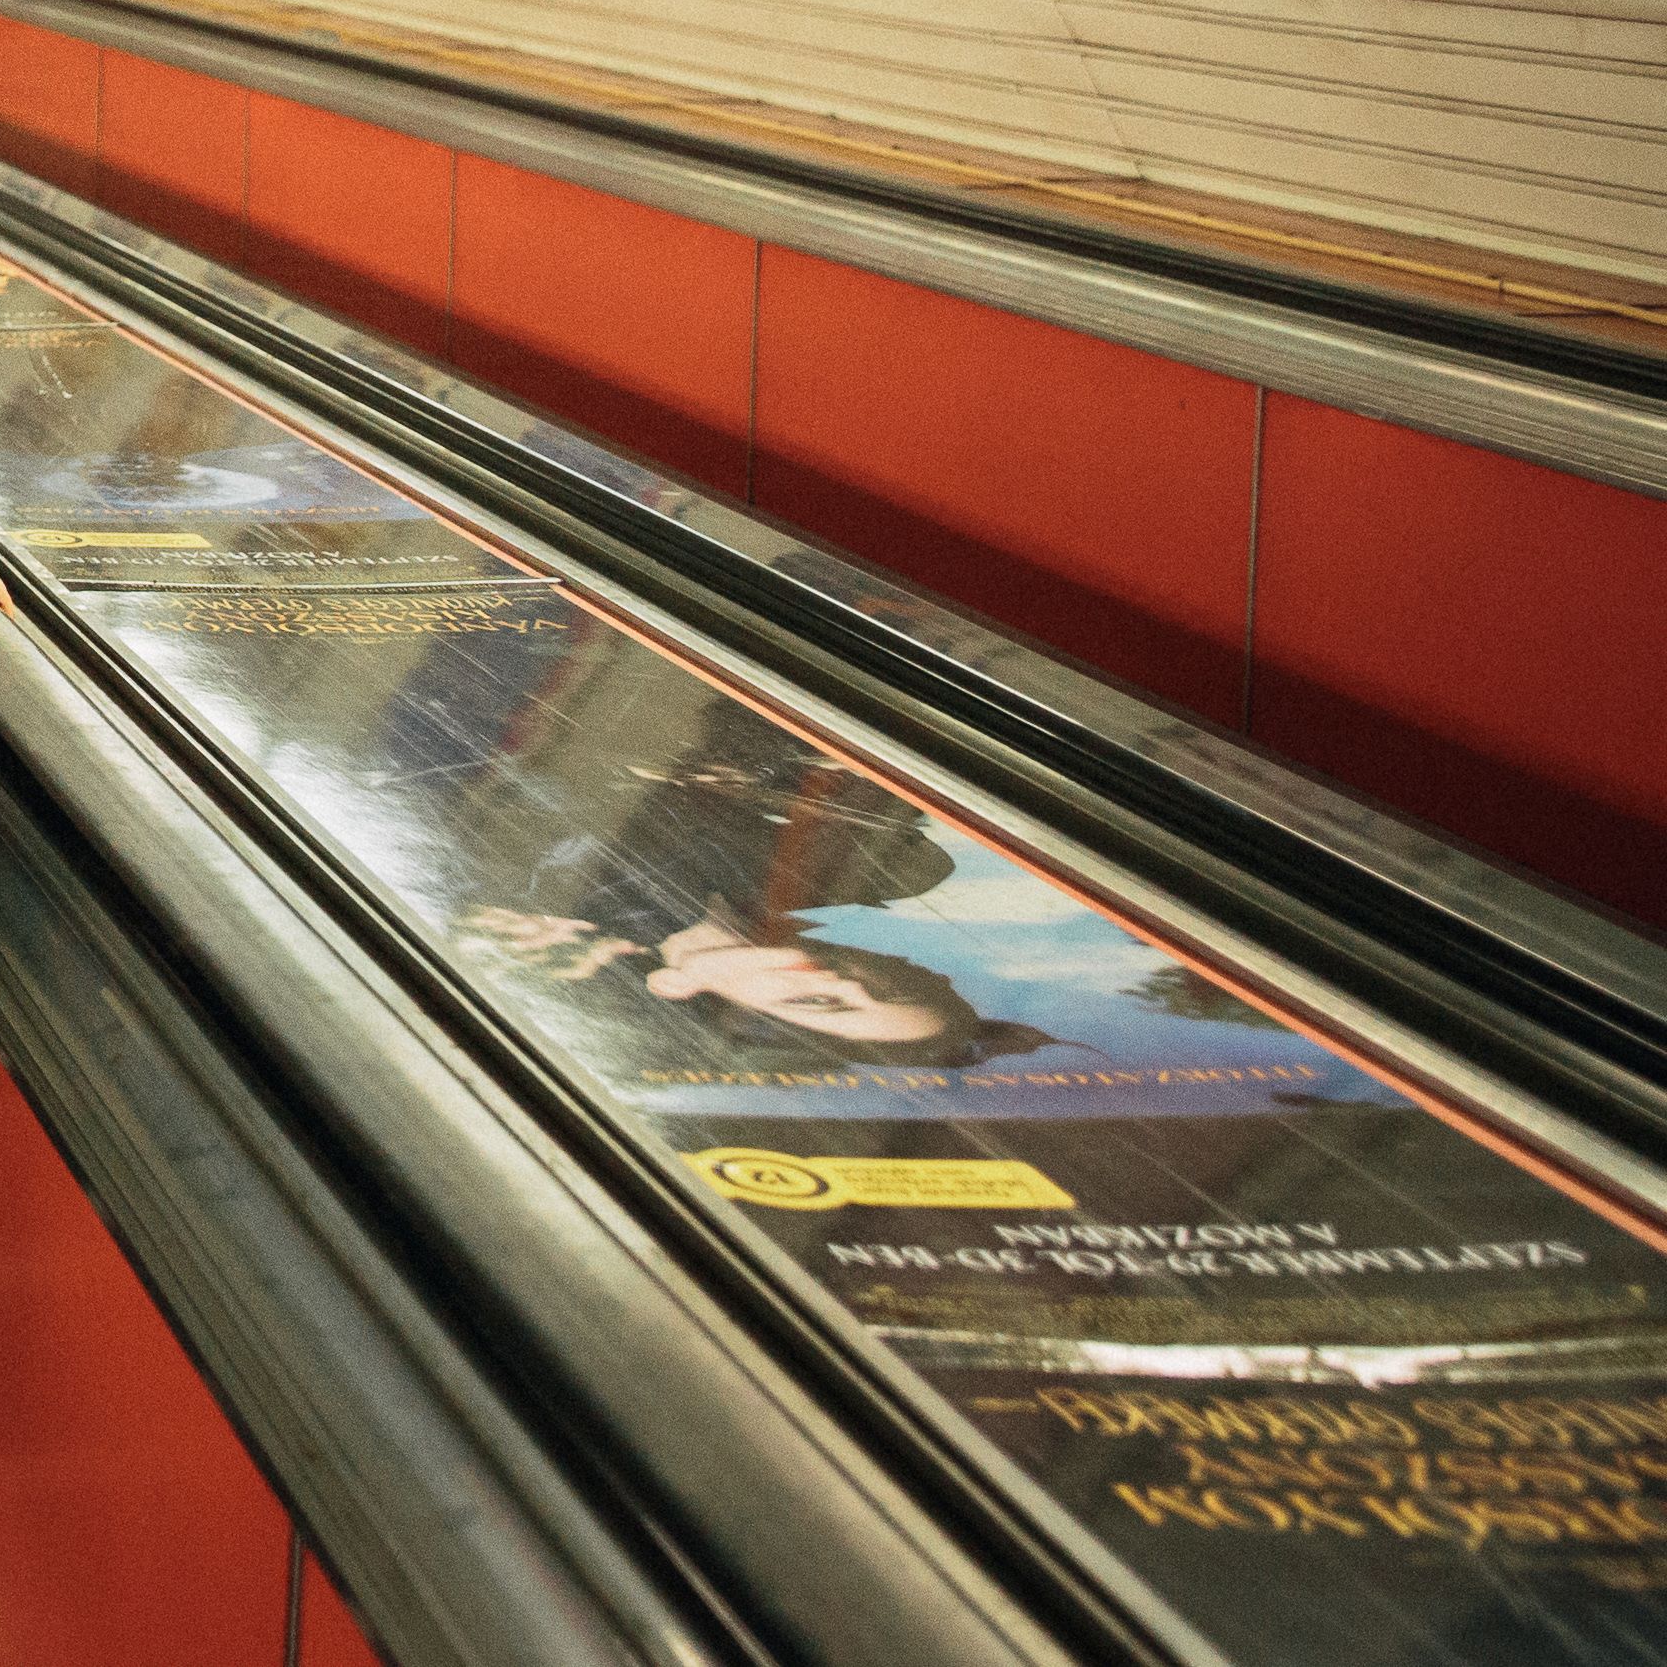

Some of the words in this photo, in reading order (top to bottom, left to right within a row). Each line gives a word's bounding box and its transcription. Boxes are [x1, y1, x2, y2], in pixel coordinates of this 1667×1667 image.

[994, 1223, 1296, 1250] MOZIKBAN
[1295, 1222, 1337, 1247] A
[828, 1242, 1038, 1275] 3D-BEN
[1228, 1241, 1590, 1277] SZEPTEMBER
